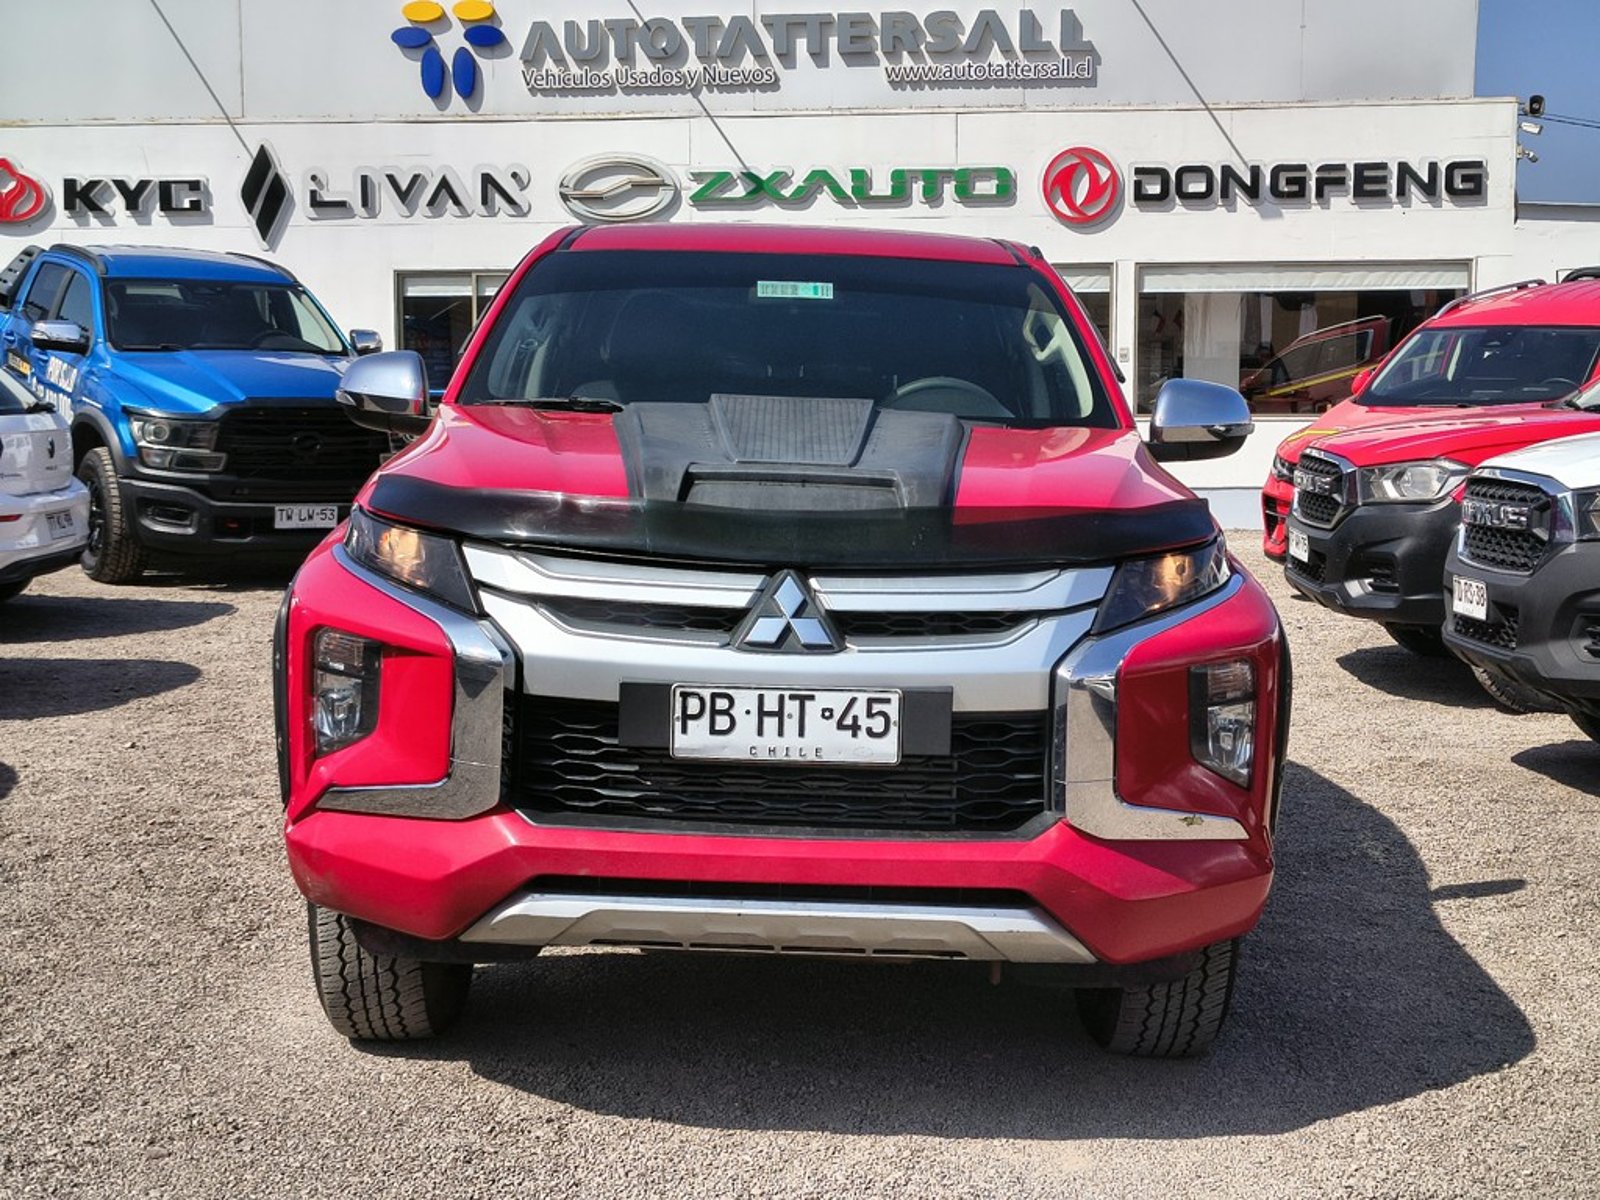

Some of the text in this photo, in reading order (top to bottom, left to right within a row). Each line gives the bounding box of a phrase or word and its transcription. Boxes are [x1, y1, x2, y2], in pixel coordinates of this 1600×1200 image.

[519, 9, 1096, 61] AUTOTATTERSALL
[522, 65, 774, 89] Vehículos Usados y Nuevos
[885, 57, 1093, 81] www.autotattersall.cl
[63, 178, 204, 212] KYC
[309, 171, 525, 208] LIVAN
[690, 166, 1012, 203] ZXAUTO
[1134, 160, 1485, 201] DONGFENG
[749, 746, 823, 759] CHILE
